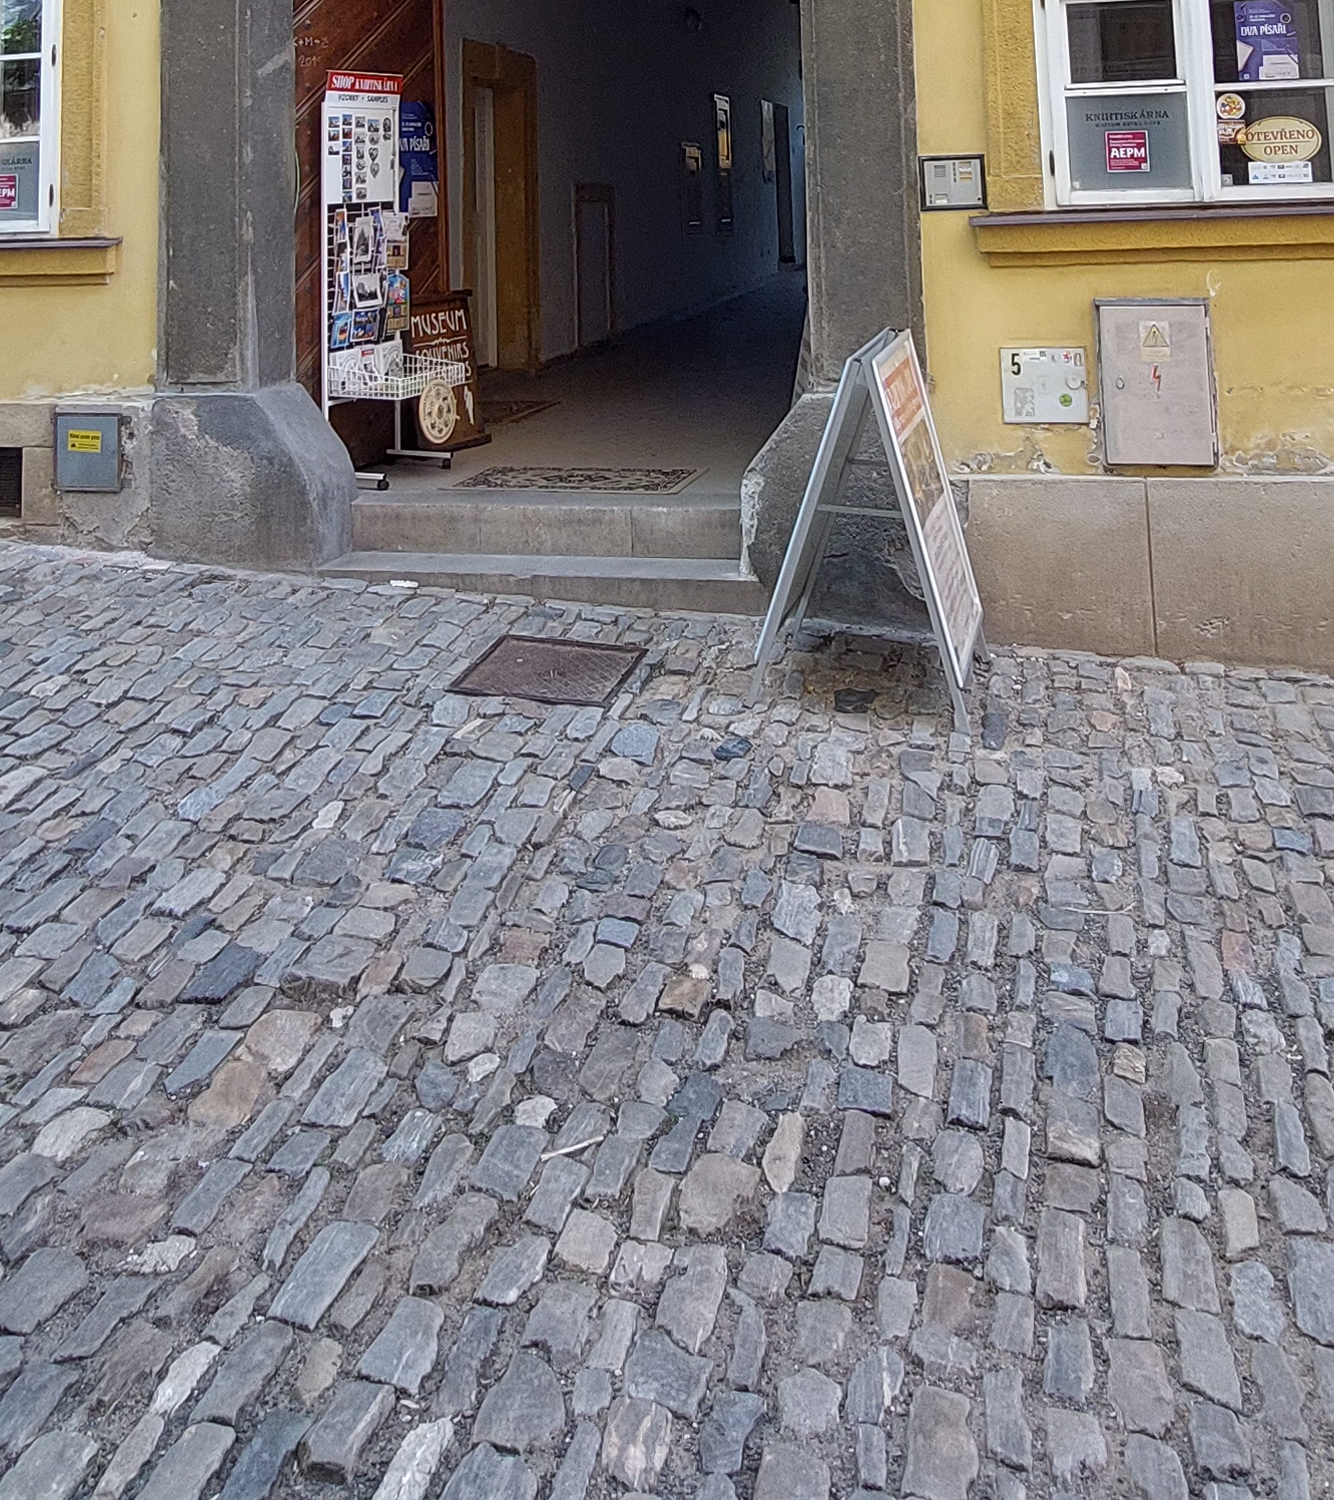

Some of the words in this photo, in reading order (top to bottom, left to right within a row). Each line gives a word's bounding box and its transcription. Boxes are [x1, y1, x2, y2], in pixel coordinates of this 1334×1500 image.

[1240, 26, 1258, 36] DVA
[331, 74, 355, 89] SHOP
[1085, 109, 1169, 122] KNIHTISKÁRNA
[1246, 128, 1315, 142] OTEVŘENO
[1110, 147, 1145, 158] AEPM
[1263, 145, 1298, 156] OPEN
[410, 309, 467, 338] MUSEUM
[1011, 353, 1022, 376] 5
